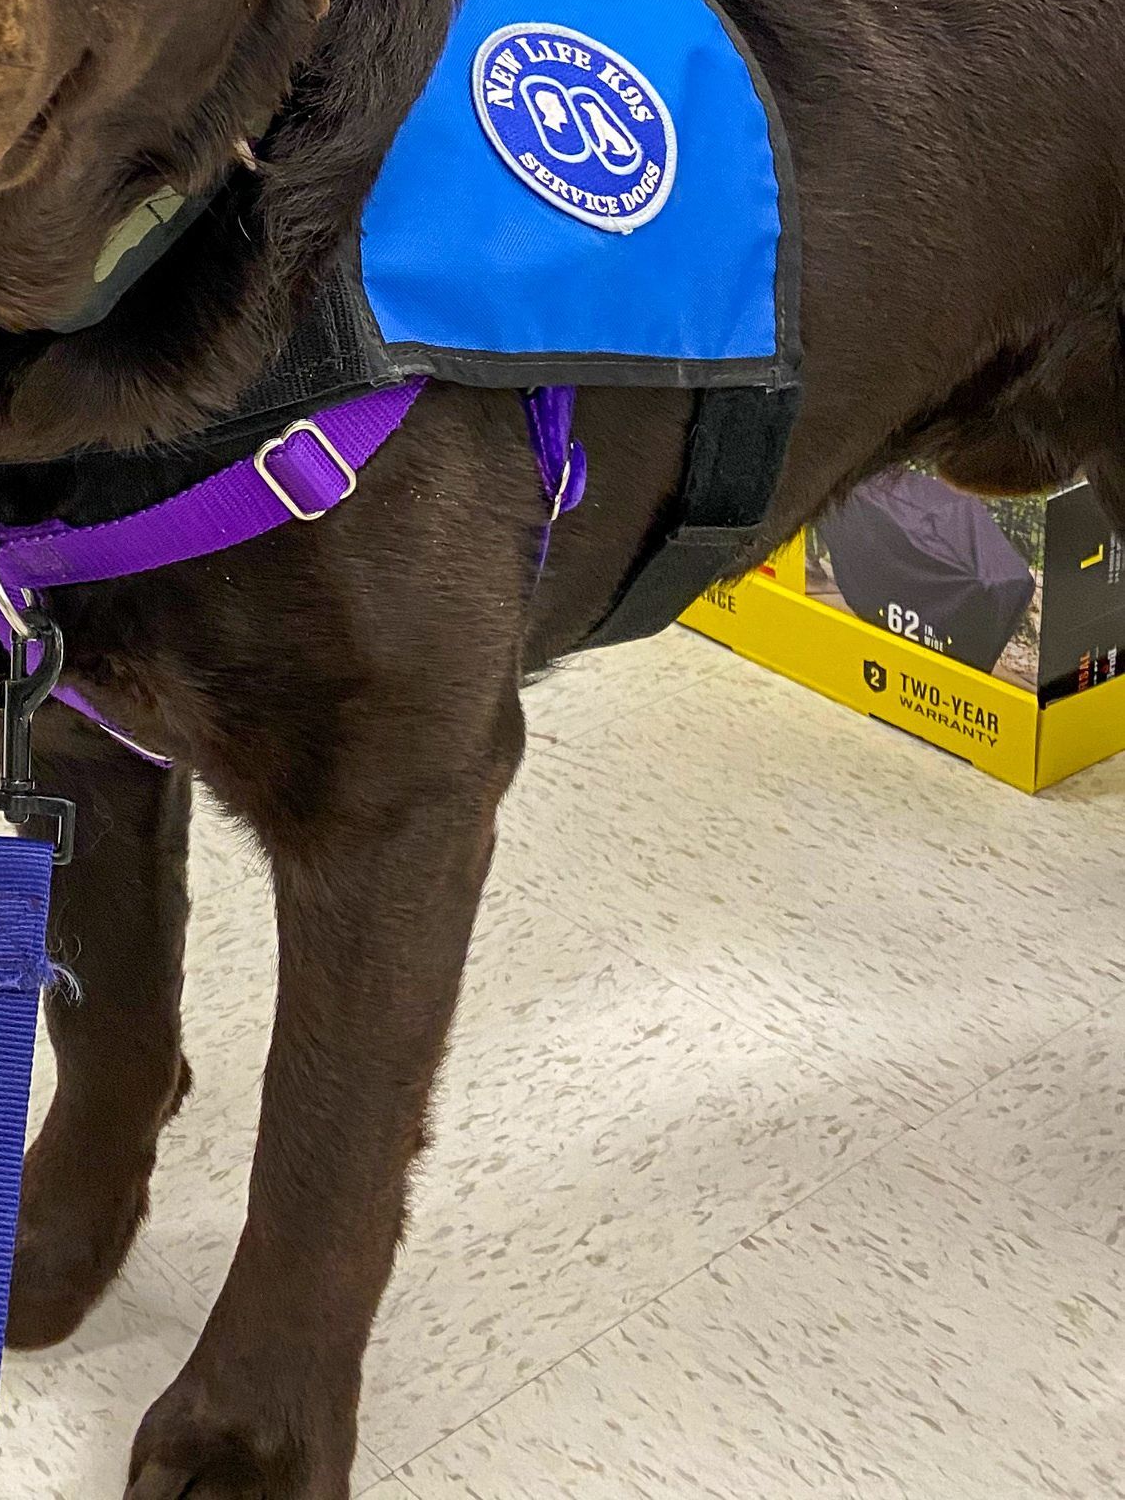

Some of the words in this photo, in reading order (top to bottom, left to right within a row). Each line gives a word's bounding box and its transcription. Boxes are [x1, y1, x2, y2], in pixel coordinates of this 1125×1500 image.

[485, 48, 523, 111] NEW
[515, 37, 592, 72] LIFE
[518, 152, 621, 215] SERVICE
[619, 160, 662, 212] DOGS
[887, 602, 921, 642] 62
[869, 666, 881, 688] 2
[899, 672, 1000, 735] TWO-YEAR
[899, 694, 999, 749] WARRANTY
